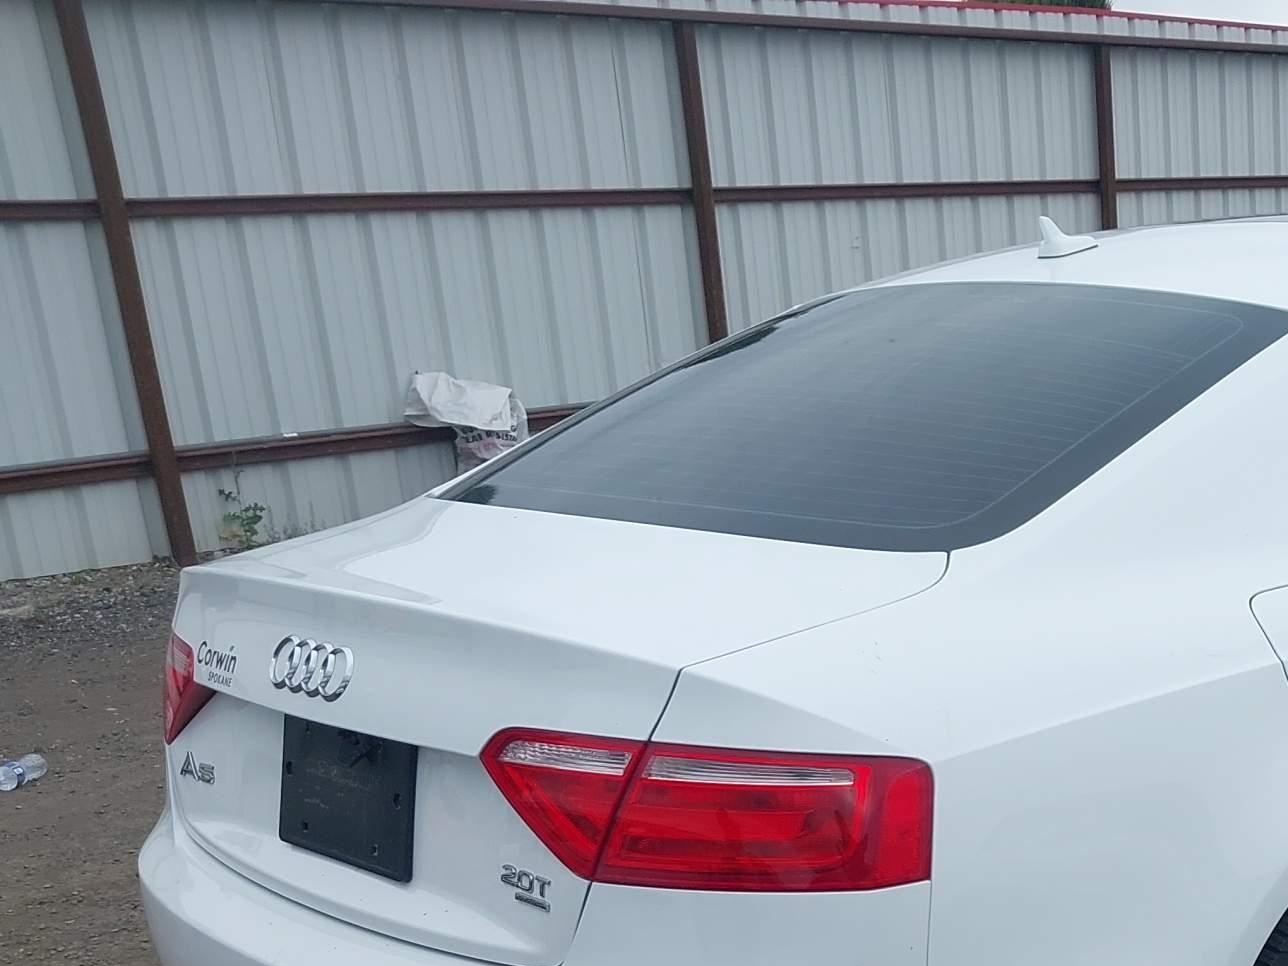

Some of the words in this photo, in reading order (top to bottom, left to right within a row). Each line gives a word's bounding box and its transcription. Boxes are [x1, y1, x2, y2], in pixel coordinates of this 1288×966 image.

[197, 640, 237, 674] Corwin
[208, 671, 232, 688] SPOKANE
[180, 751, 216, 785] A5
